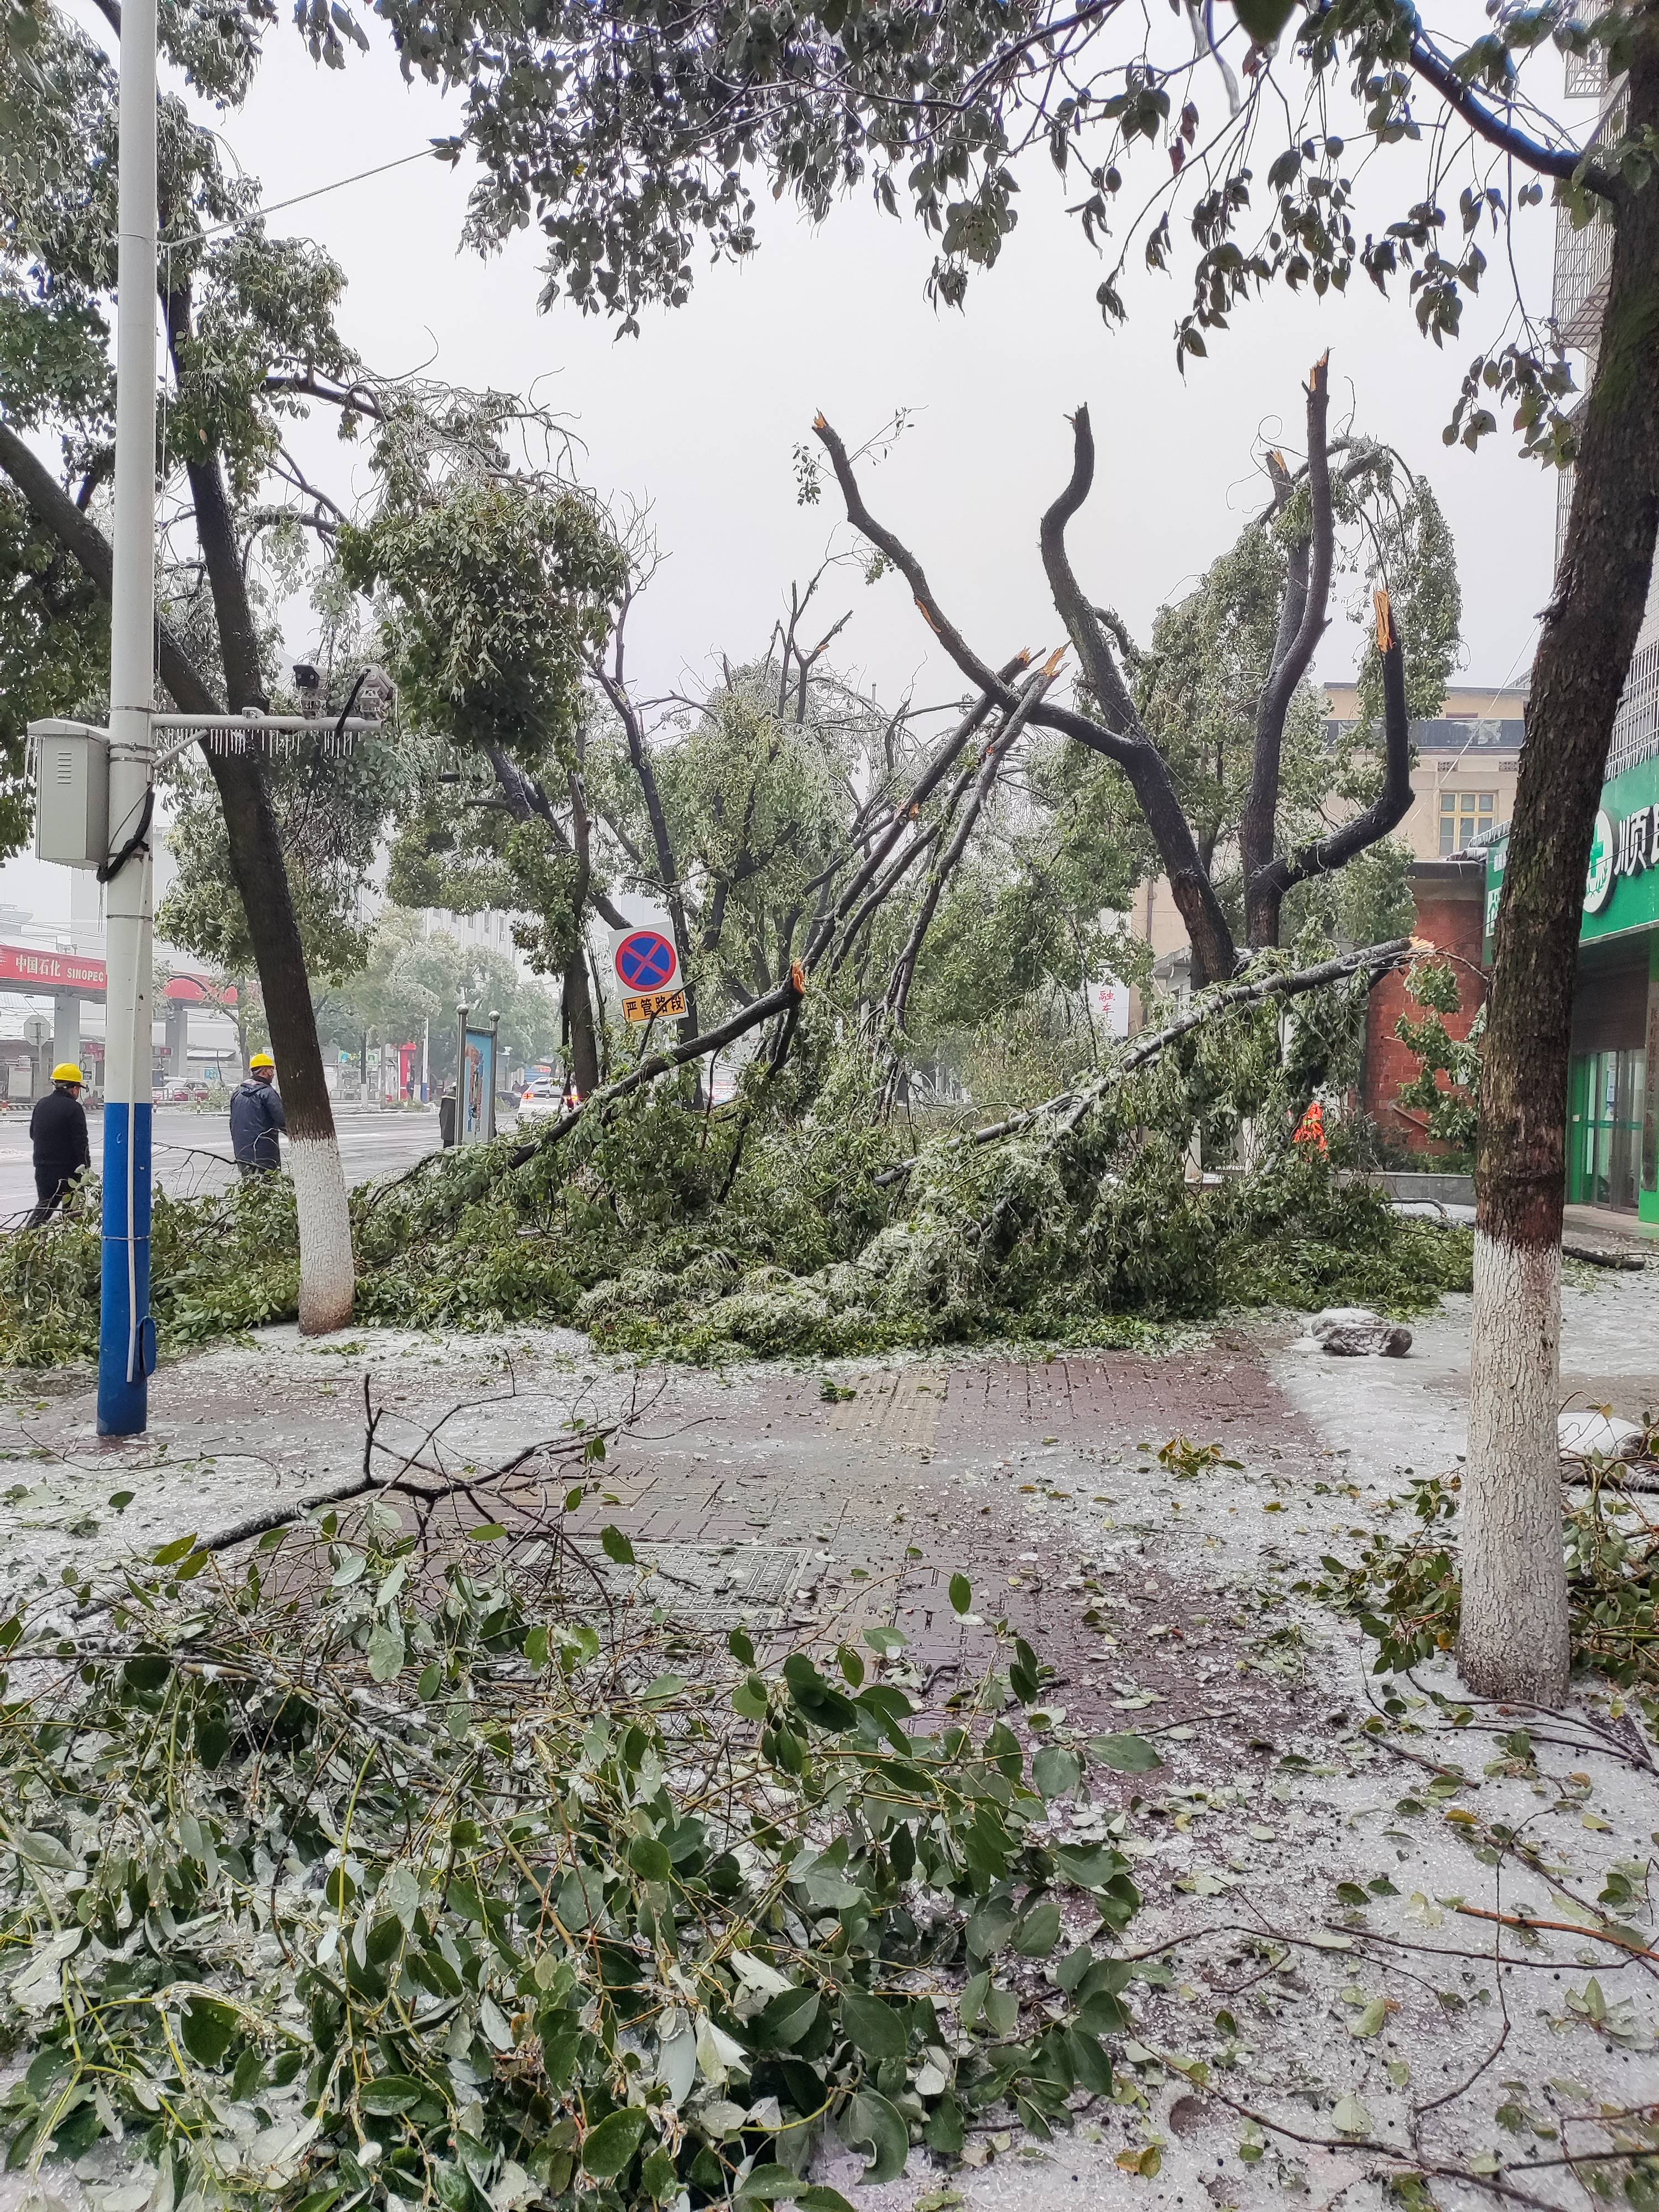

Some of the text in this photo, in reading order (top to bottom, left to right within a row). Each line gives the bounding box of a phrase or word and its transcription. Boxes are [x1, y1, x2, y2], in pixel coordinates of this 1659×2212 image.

[1614, 802, 1659, 877] 顺
[15, 954, 61, 977] 中国石化
[66, 967, 104, 983] SINOPEC
[625, 995, 684, 1018] 严管路段
